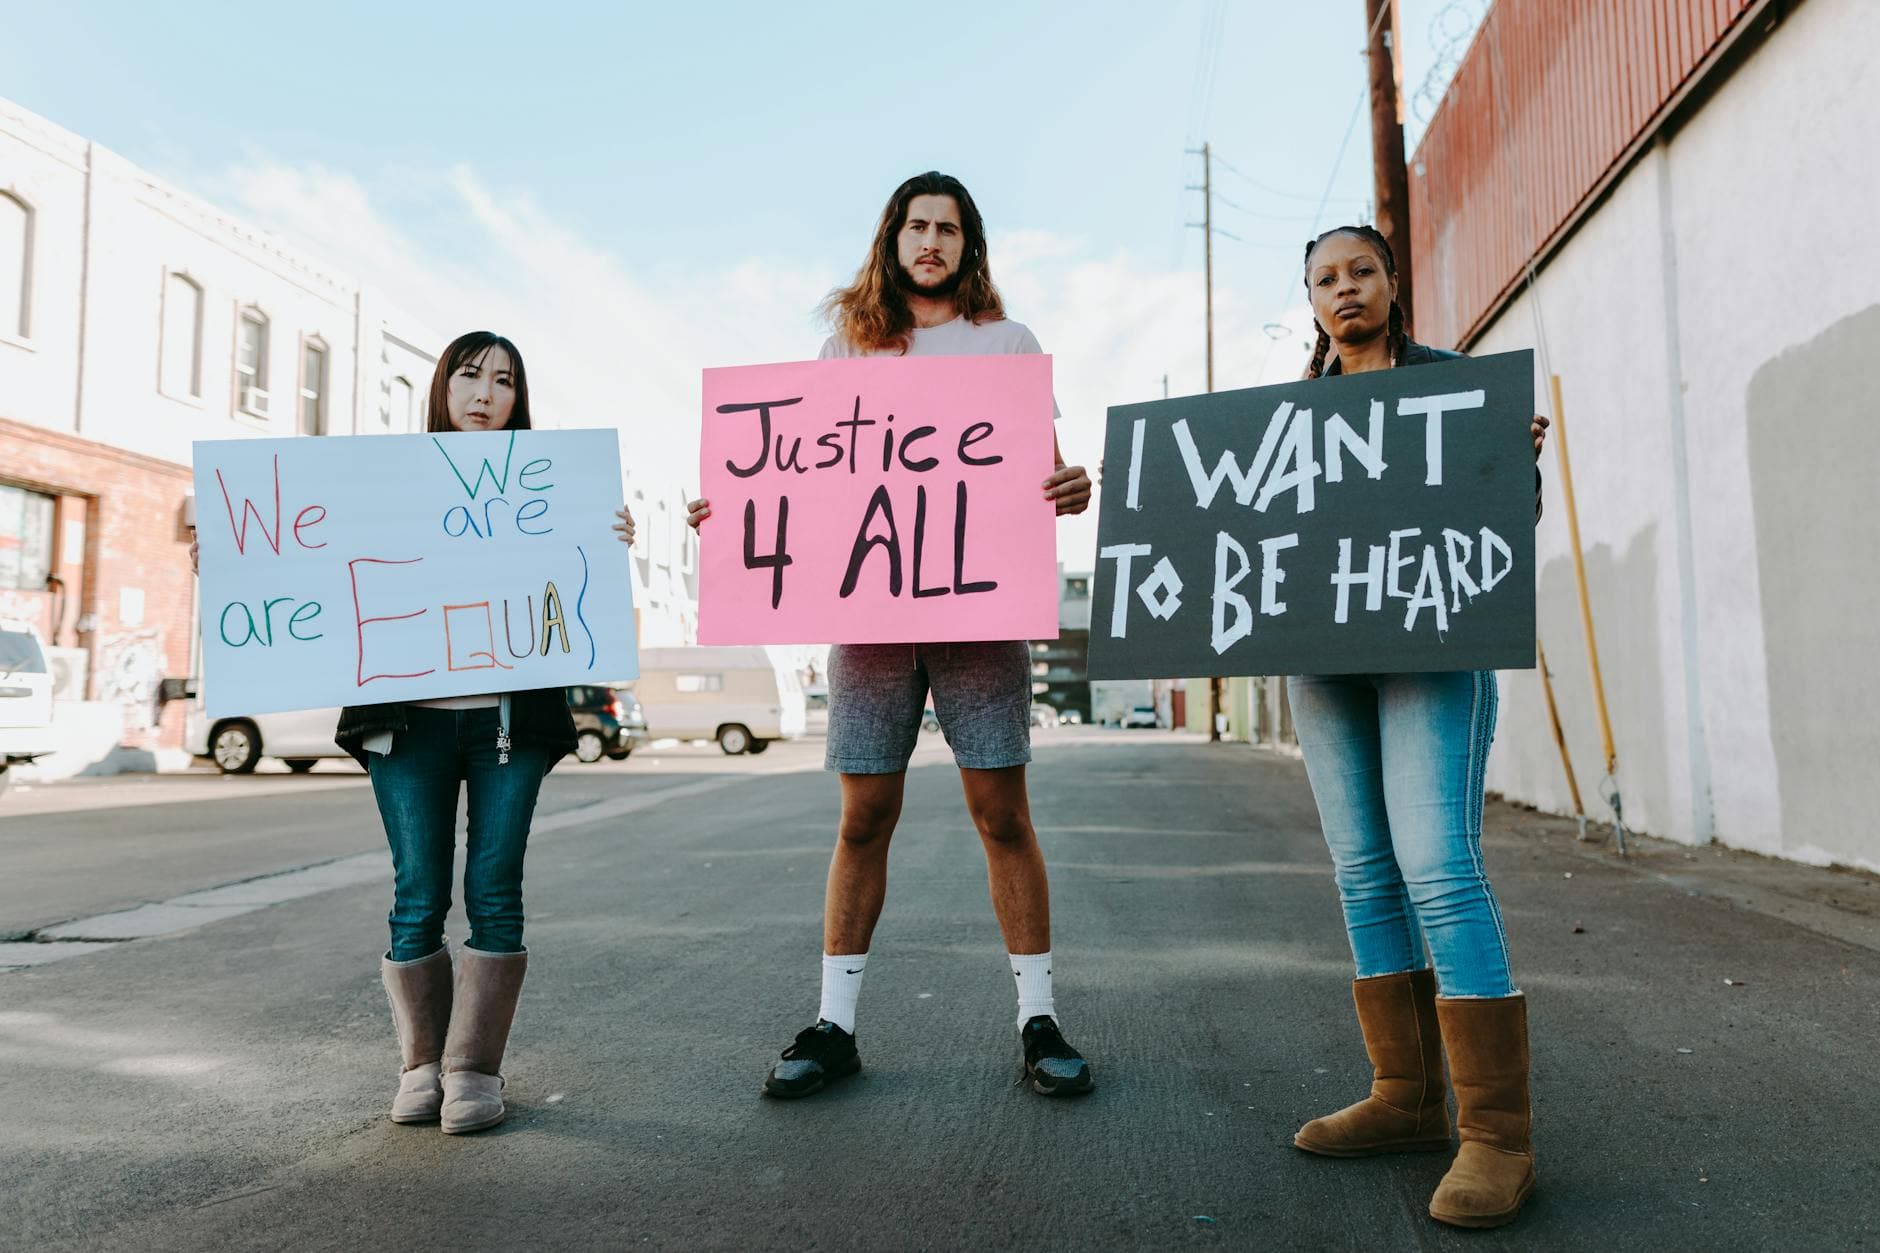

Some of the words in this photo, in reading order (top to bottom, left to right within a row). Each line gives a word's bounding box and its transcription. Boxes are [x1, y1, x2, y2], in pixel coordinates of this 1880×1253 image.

[433, 431, 554, 499] We
[717, 396, 1003, 478] Justice
[1126, 418, 1146, 511] I
[1171, 390, 1485, 513] WANT
[216, 454, 327, 555] We
[443, 496, 553, 538] are
[744, 496, 792, 609] 4
[840, 480, 997, 598] ALL
[220, 597, 323, 647] are
[1211, 531, 1298, 655] BE
[1331, 526, 1512, 635] HEARD
